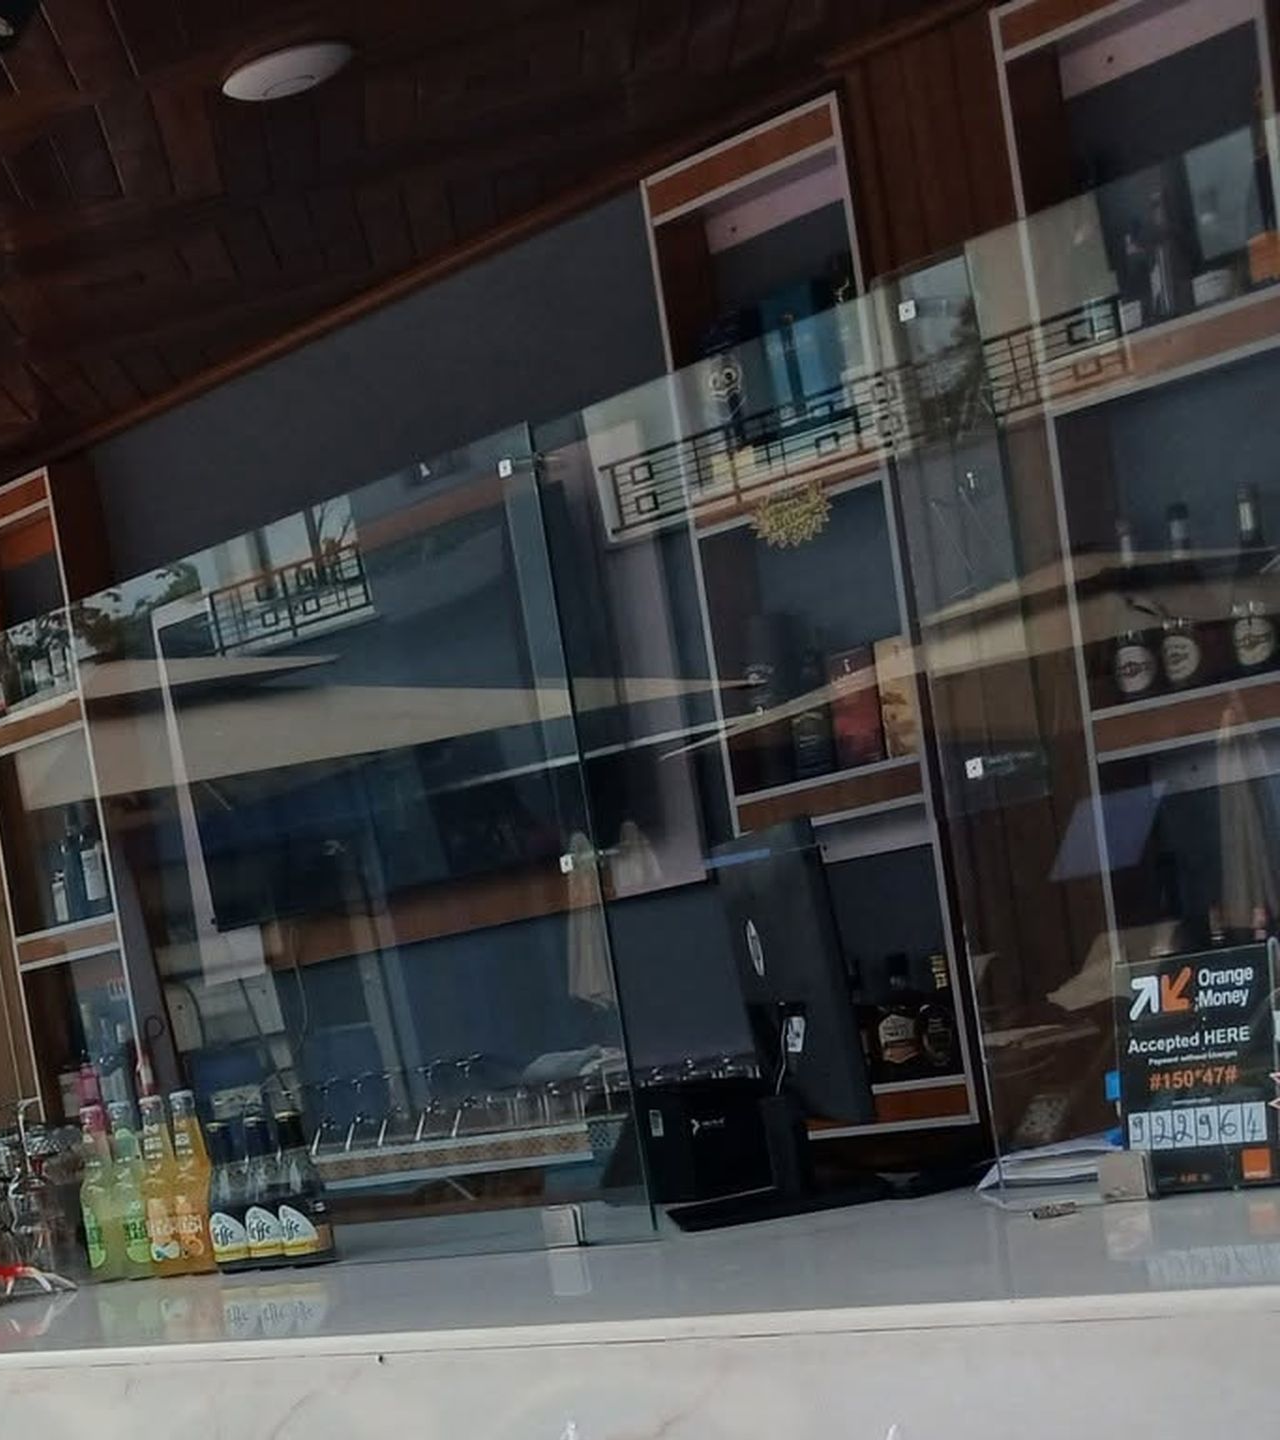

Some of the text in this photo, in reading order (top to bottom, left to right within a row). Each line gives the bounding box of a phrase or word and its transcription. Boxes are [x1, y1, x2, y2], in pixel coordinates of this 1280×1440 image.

[1198, 966, 1253, 987] Orange
[1199, 988, 1249, 1008] Money
[1127, 1025, 1251, 1054] Accepted HERE
